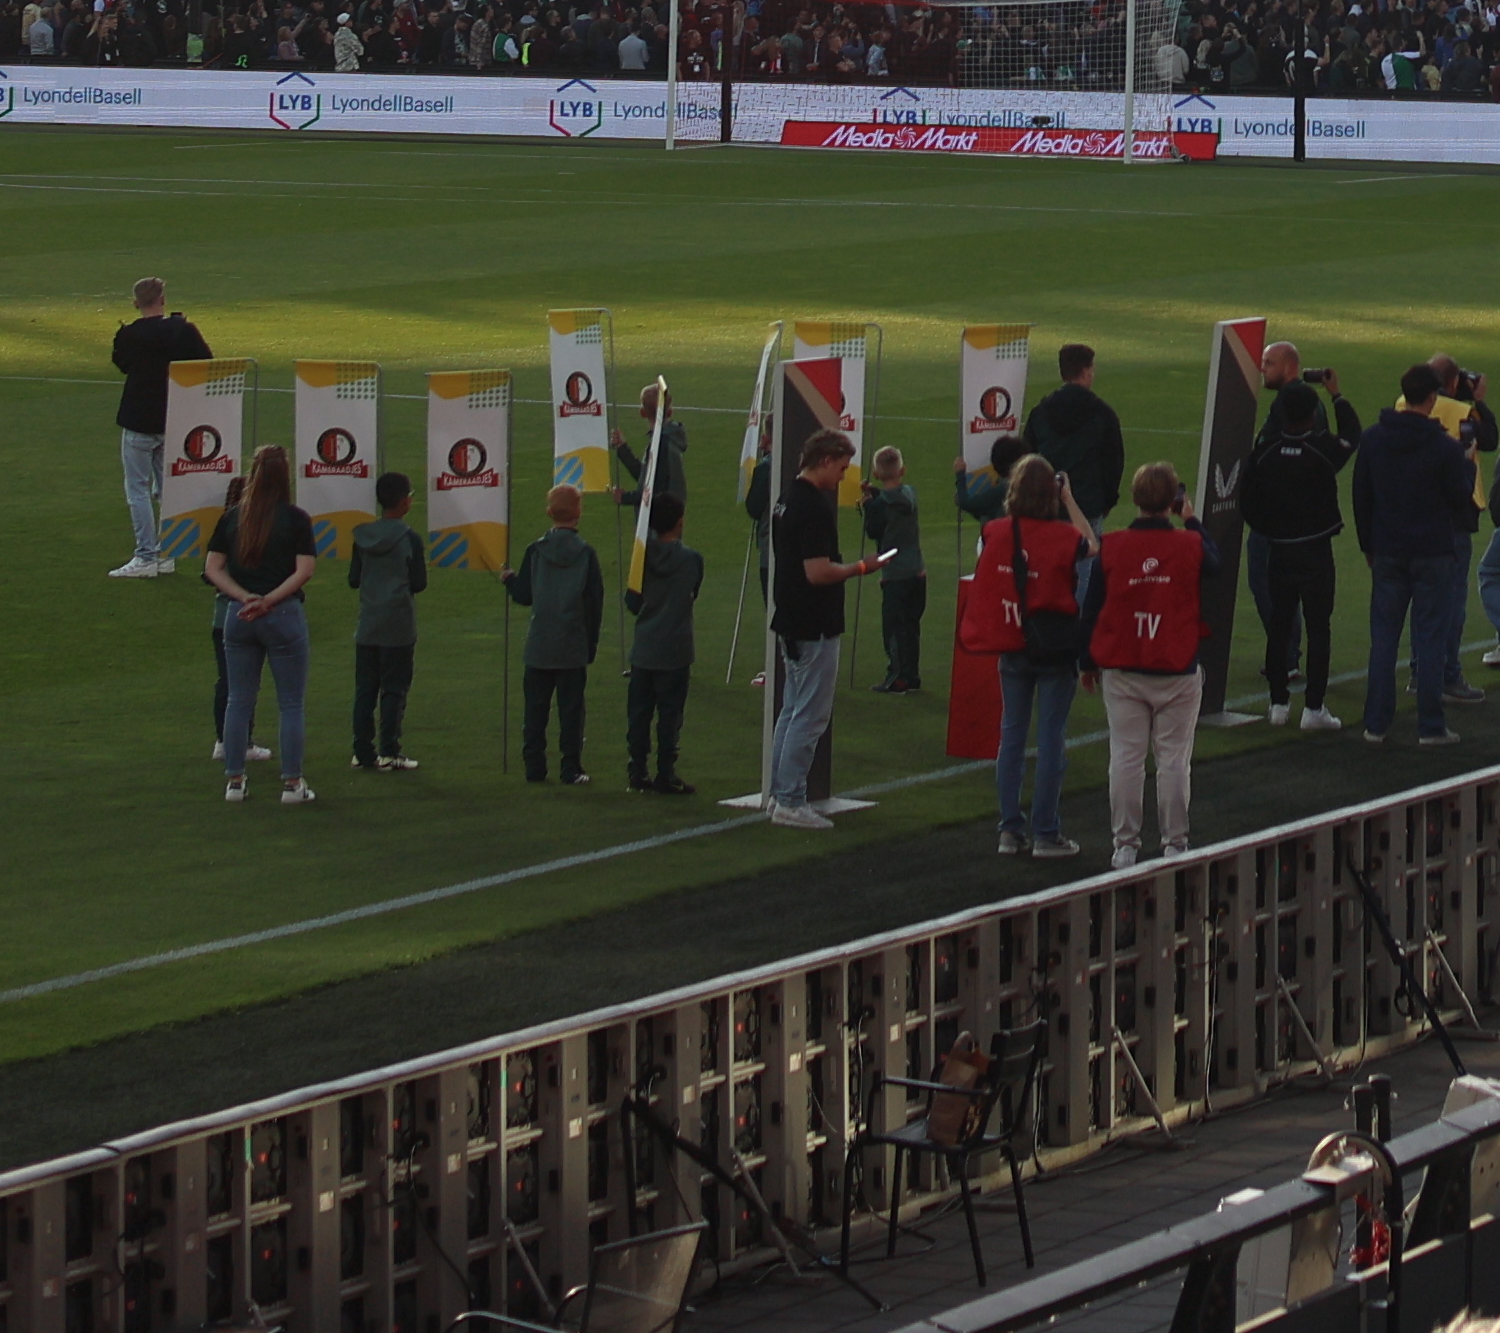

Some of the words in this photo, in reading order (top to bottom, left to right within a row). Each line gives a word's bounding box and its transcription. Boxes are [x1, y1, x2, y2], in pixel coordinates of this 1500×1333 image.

[23, 84, 142, 108] LyondellBasell
[278, 93, 313, 112] LYB
[331, 93, 454, 117] LyondellBasell
[559, 100, 594, 119] LYB
[1133, 611, 1163, 641] TV
